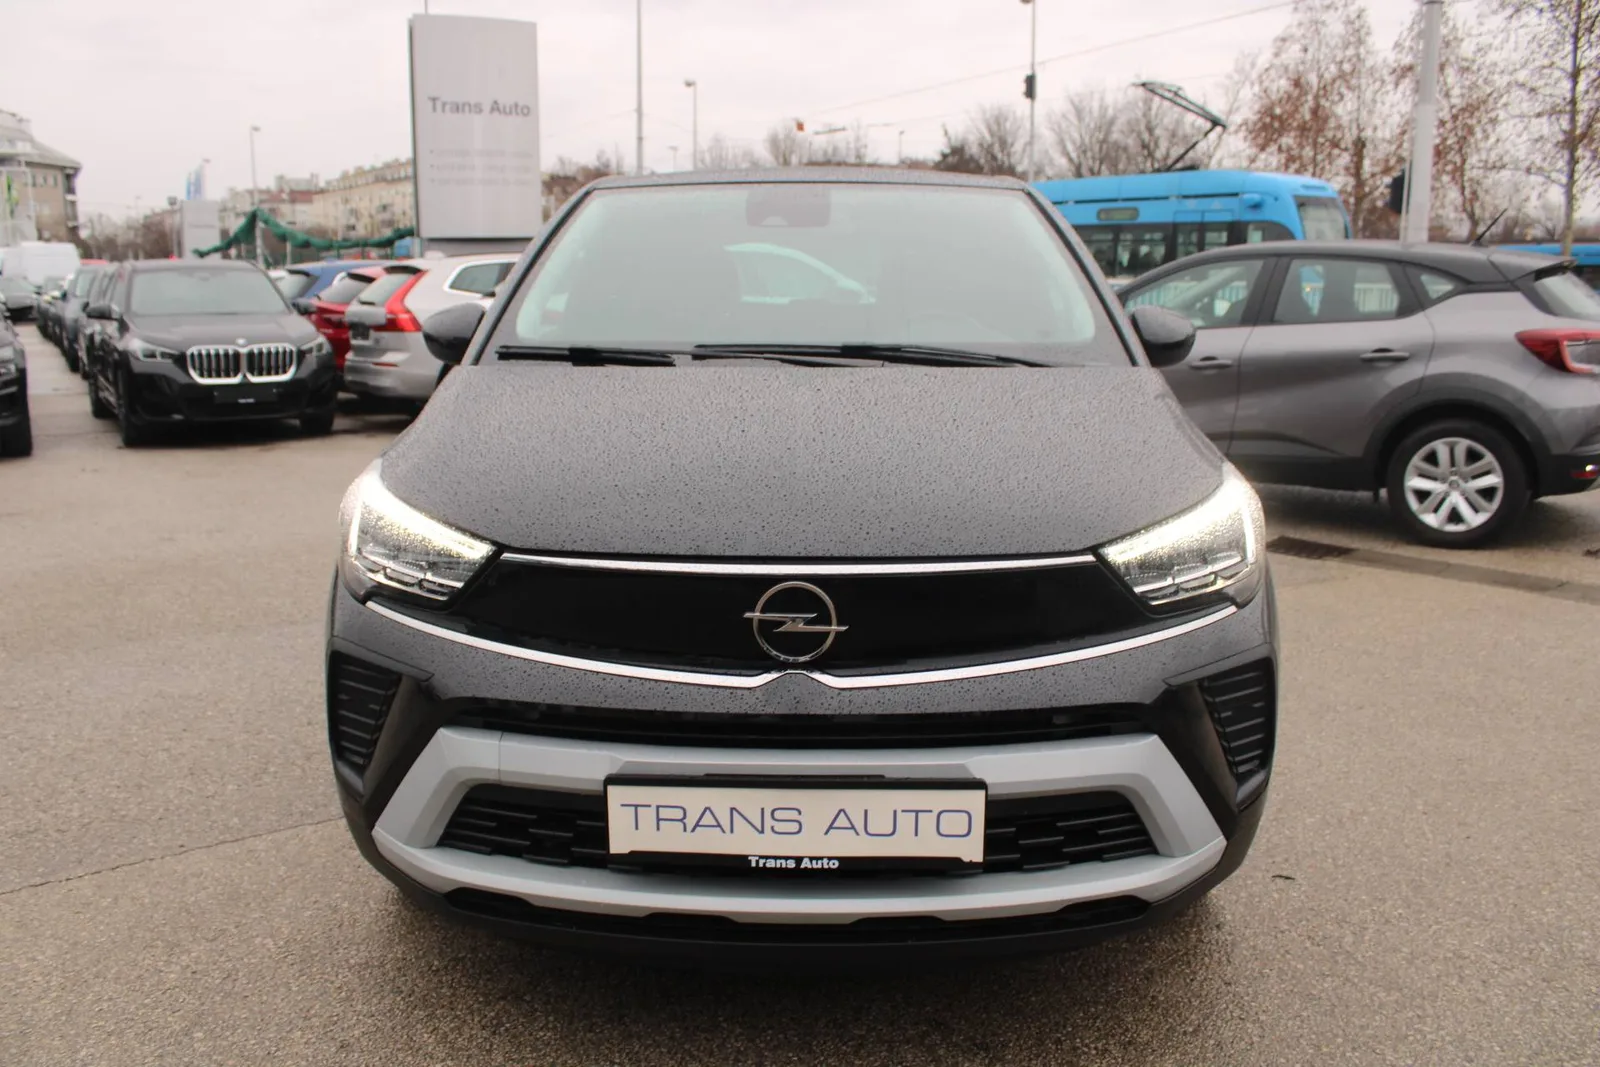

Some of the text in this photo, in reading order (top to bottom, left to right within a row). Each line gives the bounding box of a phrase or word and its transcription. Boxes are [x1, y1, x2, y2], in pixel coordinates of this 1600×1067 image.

[428, 96, 531, 117] Trans Auto
[620, 803, 973, 838] TRANS AUTO
[748, 855, 840, 870] Trans Auto
